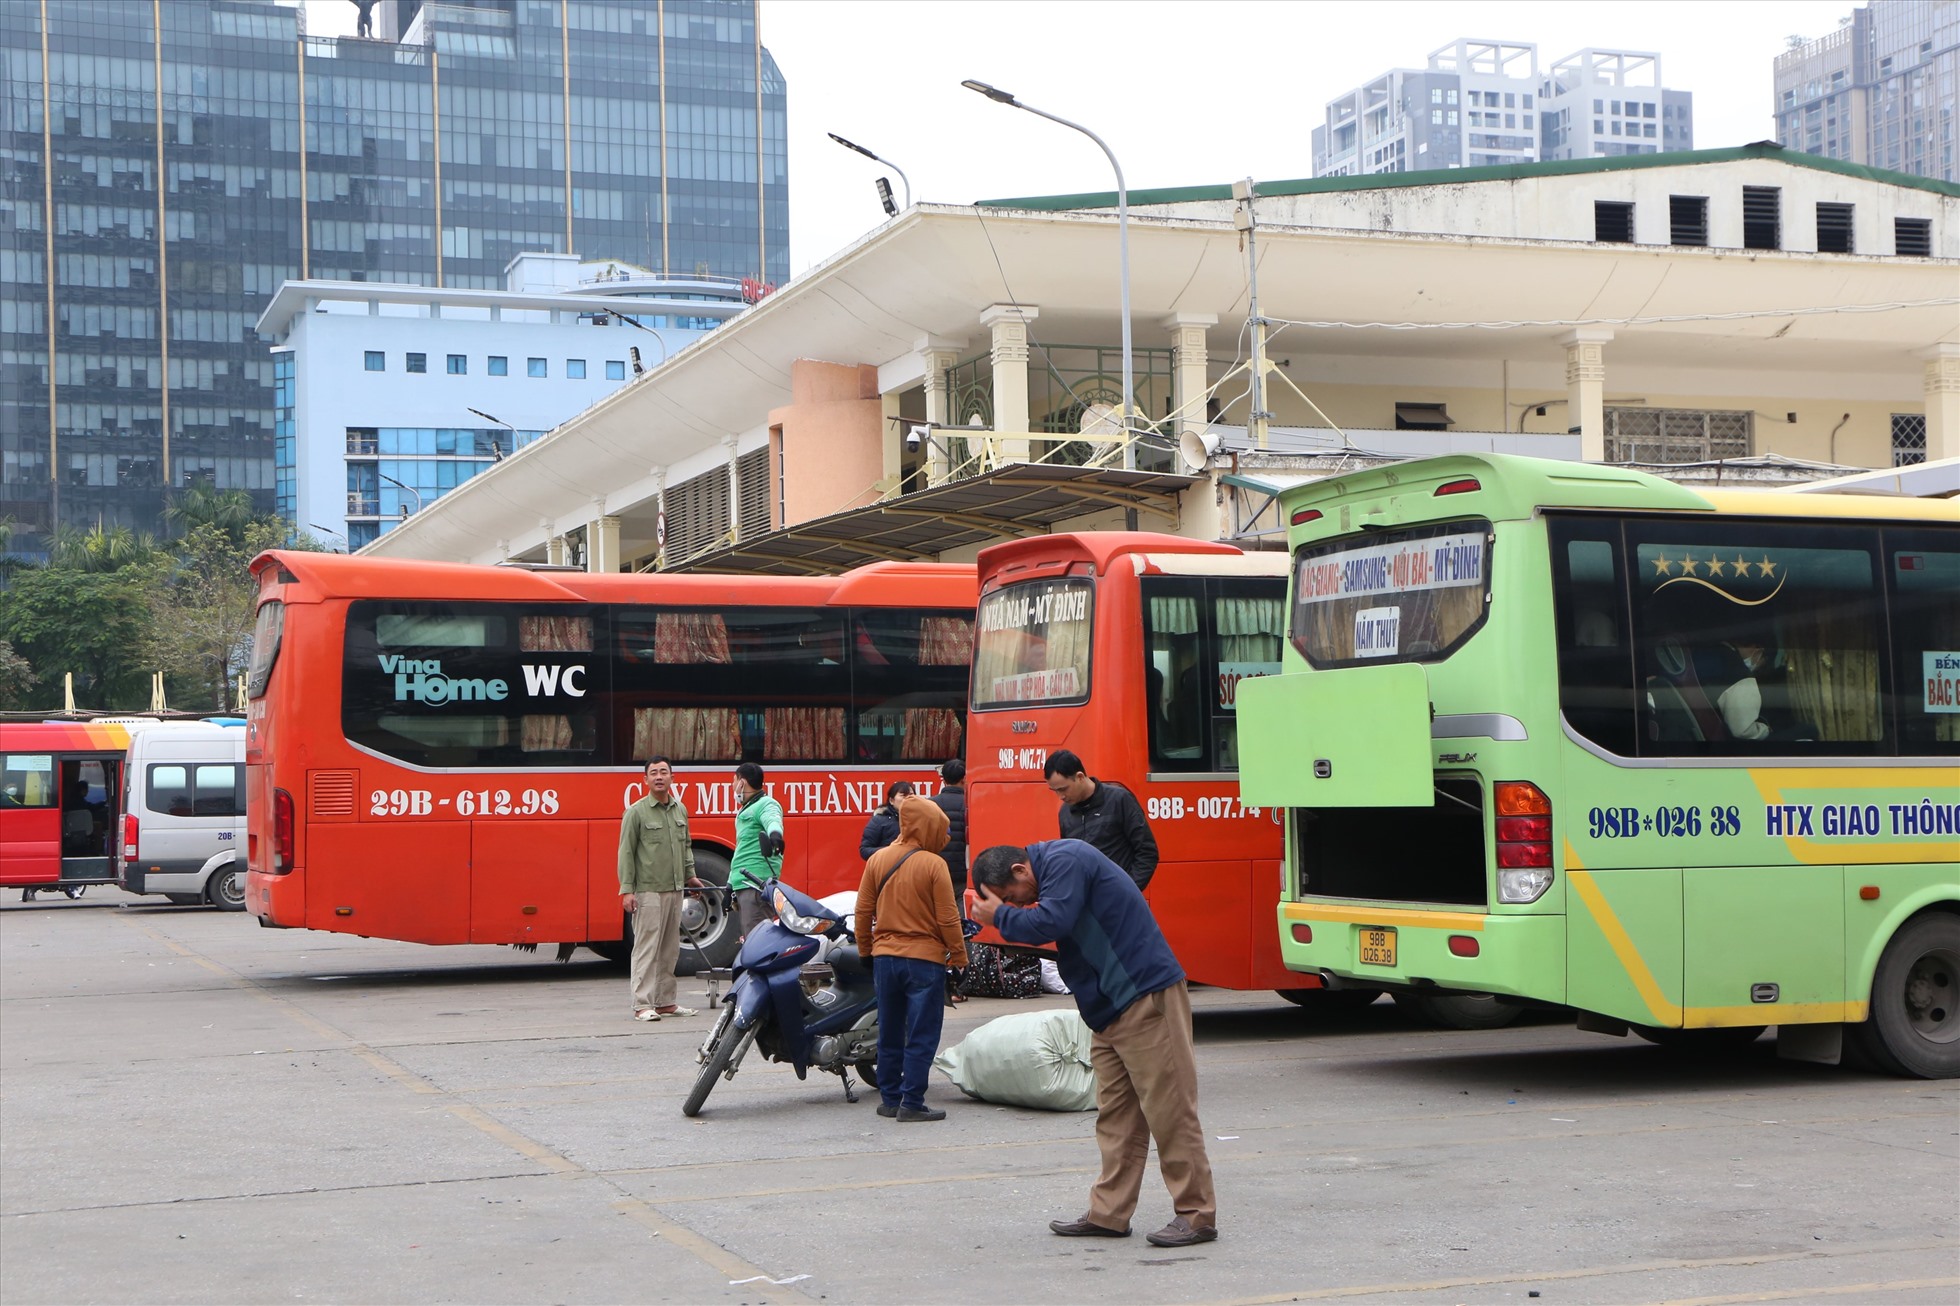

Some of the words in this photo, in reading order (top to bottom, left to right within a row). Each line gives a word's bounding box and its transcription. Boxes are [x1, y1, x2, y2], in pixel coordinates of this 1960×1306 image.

[1315, 563, 1339, 597] GIANG
[1344, 556, 1387, 592] SAMSUNG
[1393, 546, 1409, 592] NỘI
[1411, 545, 1428, 586] BÀI
[1434, 542, 1451, 583] MỸ
[1452, 538, 1481, 581] ĐÌNH
[1005, 597, 1029, 629] NAM
[1034, 586, 1054, 625] MỸ
[1355, 614, 1374, 650] NĂM
[377, 654, 441, 675] Vina
[1935, 653, 1960, 670] BẾN
[395, 672, 509, 707] Home
[521, 664, 587, 697] WC
[1928, 670, 1952, 706] BẮC
[784, 773, 885, 814] THÀNH
[1766, 804, 1814, 836] HTX
[1822, 804, 1881, 836] GIAO
[1363, 947, 1392, 963] 026.38
[1369, 932, 1386, 946] 98B
